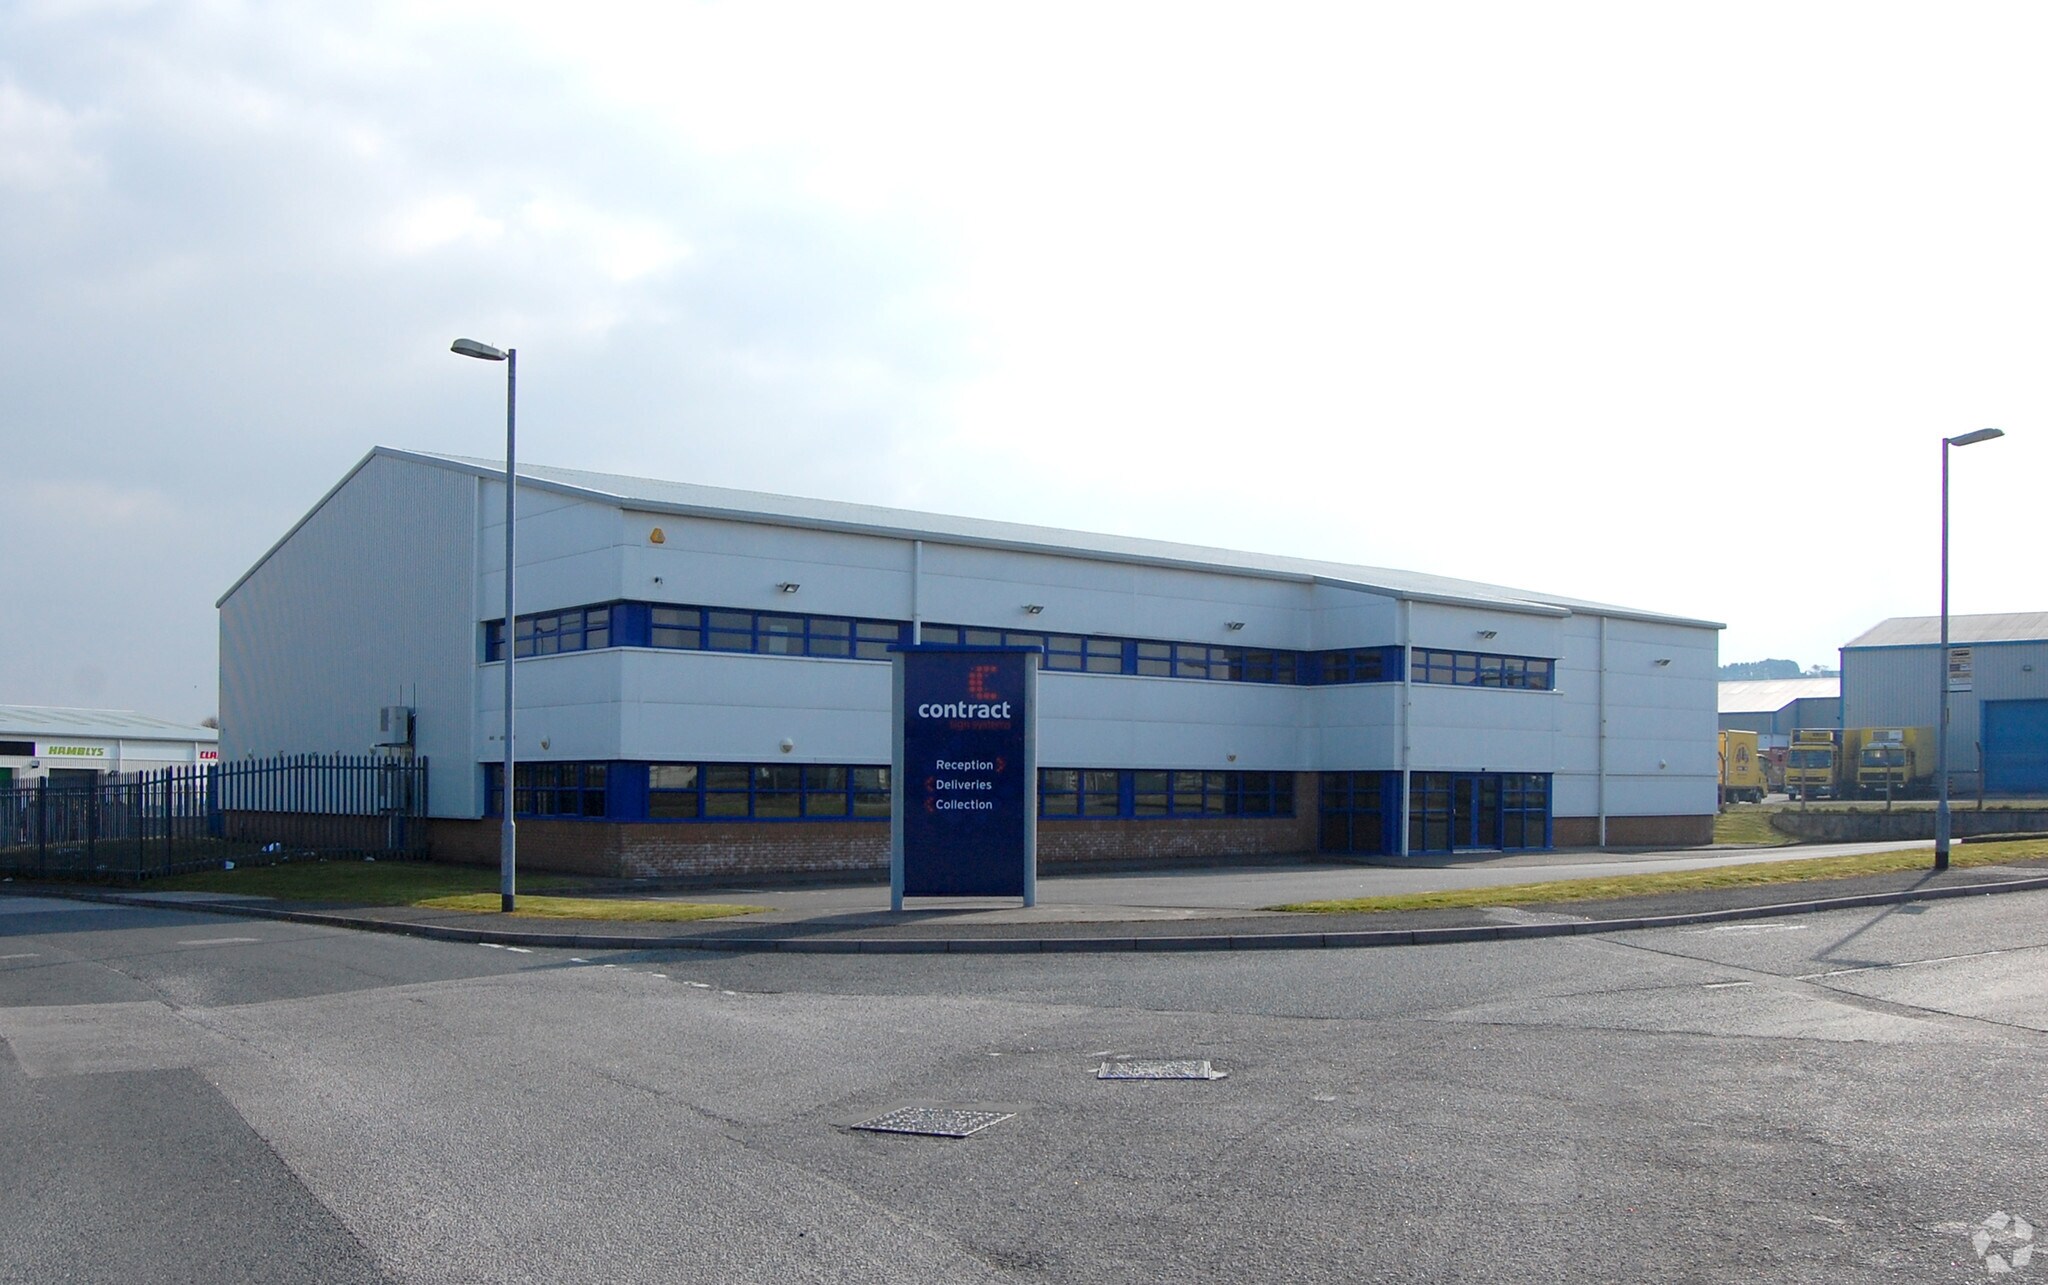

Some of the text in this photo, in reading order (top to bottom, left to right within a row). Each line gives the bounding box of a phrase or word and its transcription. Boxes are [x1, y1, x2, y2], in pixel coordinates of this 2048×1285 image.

[918, 701, 1011, 718] contract
[48, 746, 104, 756] HAMBLYS
[936, 760, 993, 771] Reception
[936, 780, 992, 790] Deliveries
[936, 799, 993, 810] Collection
